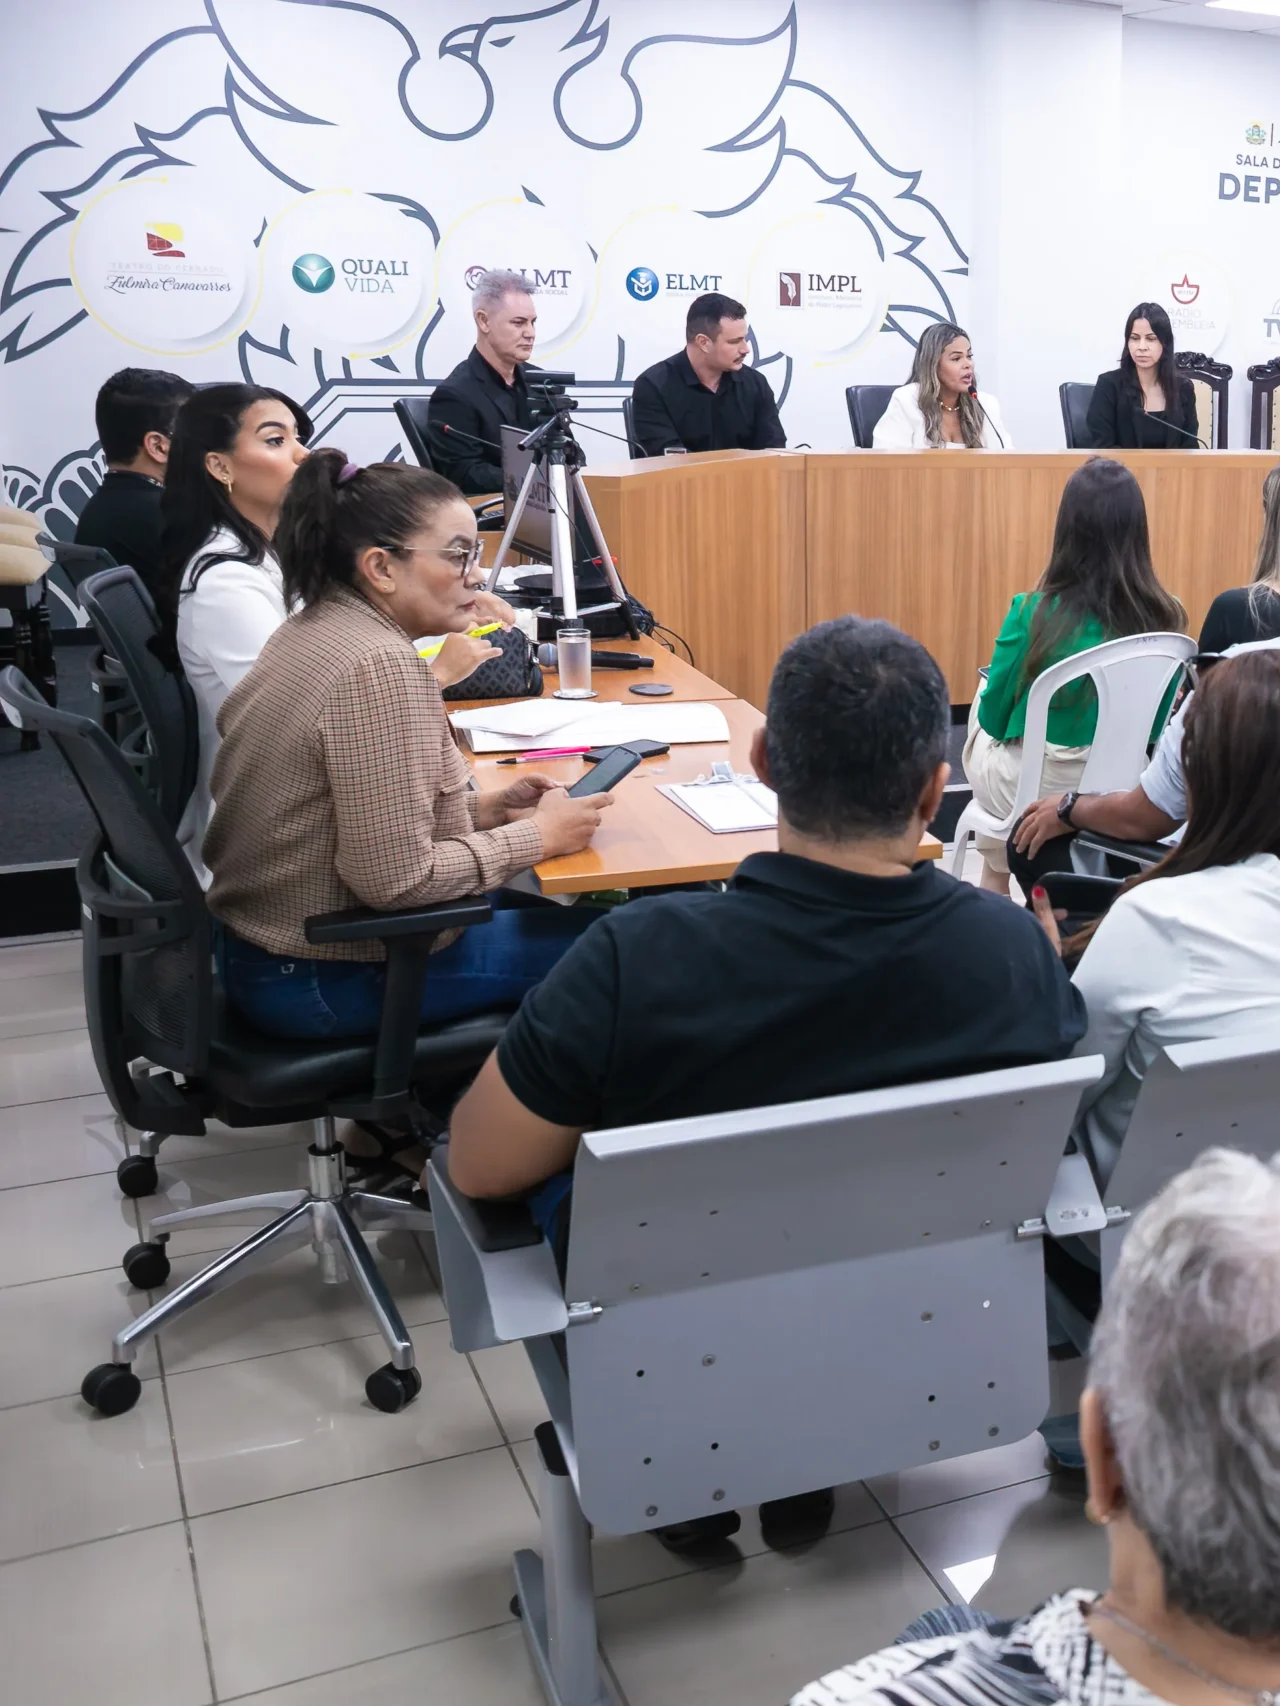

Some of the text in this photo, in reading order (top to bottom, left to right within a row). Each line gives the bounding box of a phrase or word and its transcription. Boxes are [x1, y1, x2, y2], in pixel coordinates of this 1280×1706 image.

[1236, 153, 1269, 168] SALA
[341, 258, 409, 277] QUALI
[159, 277, 233, 292] Canavarros
[344, 277, 395, 293] VIDA
[665, 273, 722, 291] ELMT
[808, 274, 862, 293] IMPL
